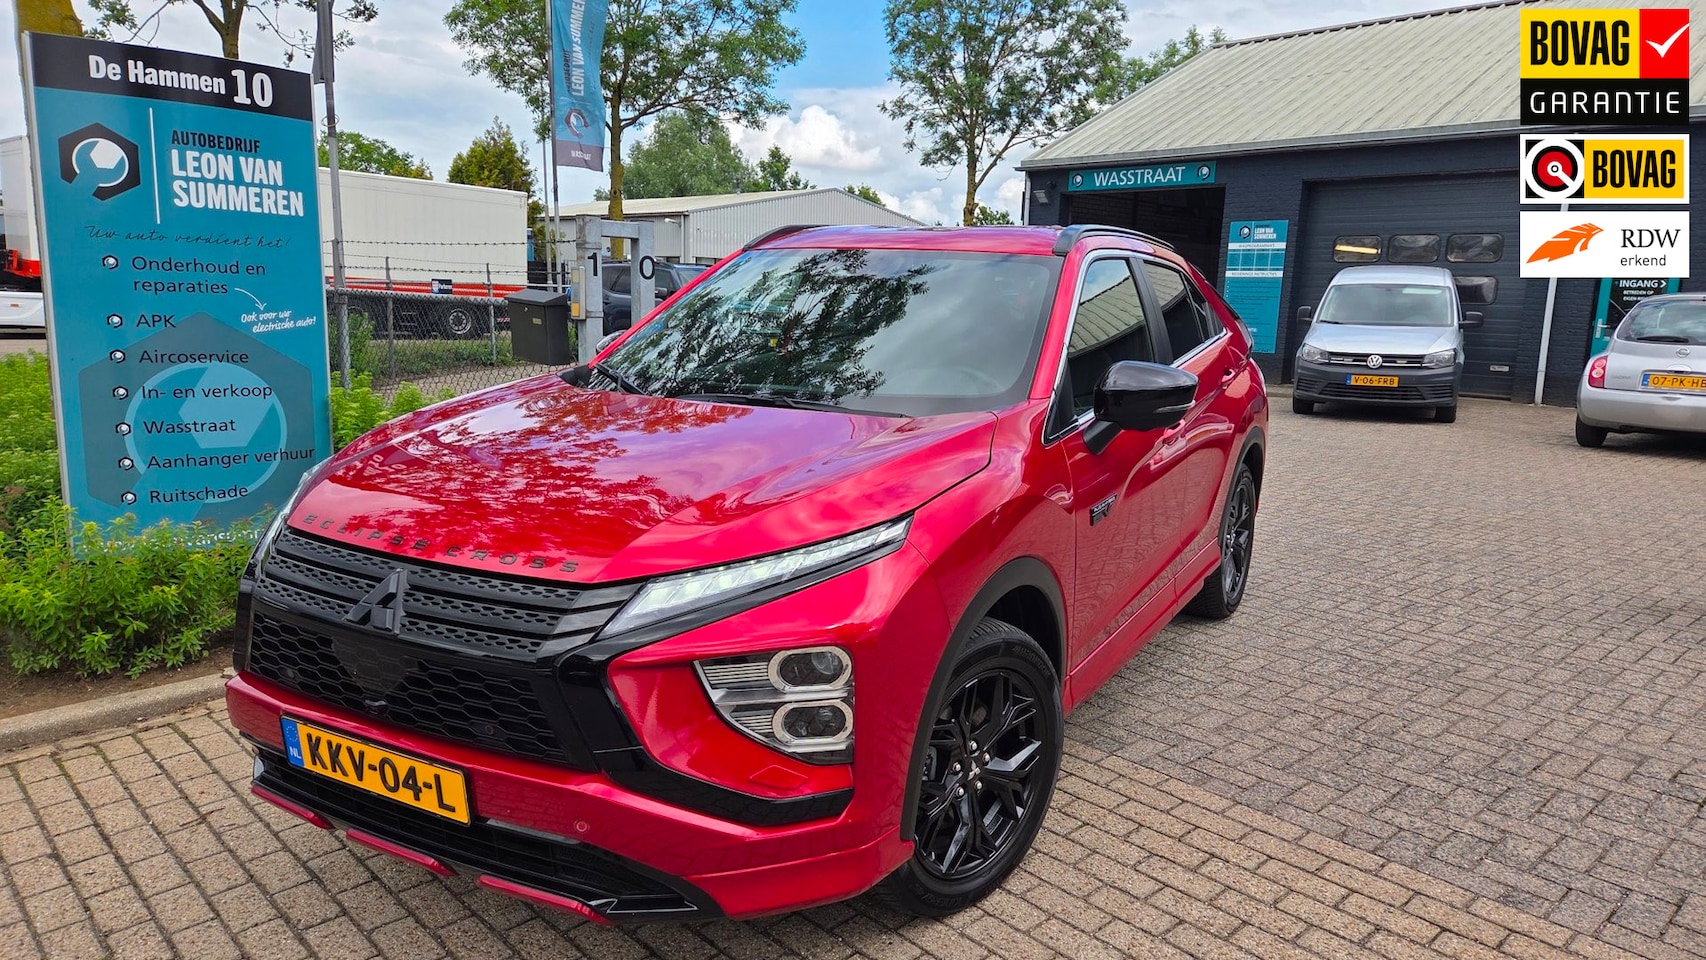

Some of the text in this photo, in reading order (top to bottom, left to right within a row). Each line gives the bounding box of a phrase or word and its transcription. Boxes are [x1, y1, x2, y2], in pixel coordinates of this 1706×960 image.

[572, 44, 585, 65] VAN
[88, 54, 274, 108] De Hammen 10
[571, 67, 585, 96] LEON
[171, 129, 261, 154] AUTOBEDRIJF
[171, 149, 283, 187] LEON VAN
[1094, 166, 1186, 187] WASSTRAAT
[172, 180, 305, 217] SUMMEREN
[84, 224, 292, 249] Uw auto verdient het!
[131, 256, 267, 276] Onderhoud en
[587, 252, 656, 281] 1 0
[133, 280, 229, 296] reparaties
[1619, 280, 1659, 288] INGANG
[136, 315, 176, 328] APK
[240, 310, 292, 323] Ook voor uw
[252, 316, 317, 333] electrische auto!
[139, 350, 249, 363] Aircoservice
[1354, 376, 1395, 385] V-06-FRB
[142, 384, 273, 400] In- en verkoop
[144, 419, 236, 434] Wasstraat
[147, 448, 315, 470] Aanhanger verhuur
[150, 484, 248, 504] Ruitschade
[303, 515, 430, 550] ECLIPSE
[446, 545, 579, 573] CROSS
[289, 746, 302, 759] NL
[306, 732, 456, 813] KKV-04-L
